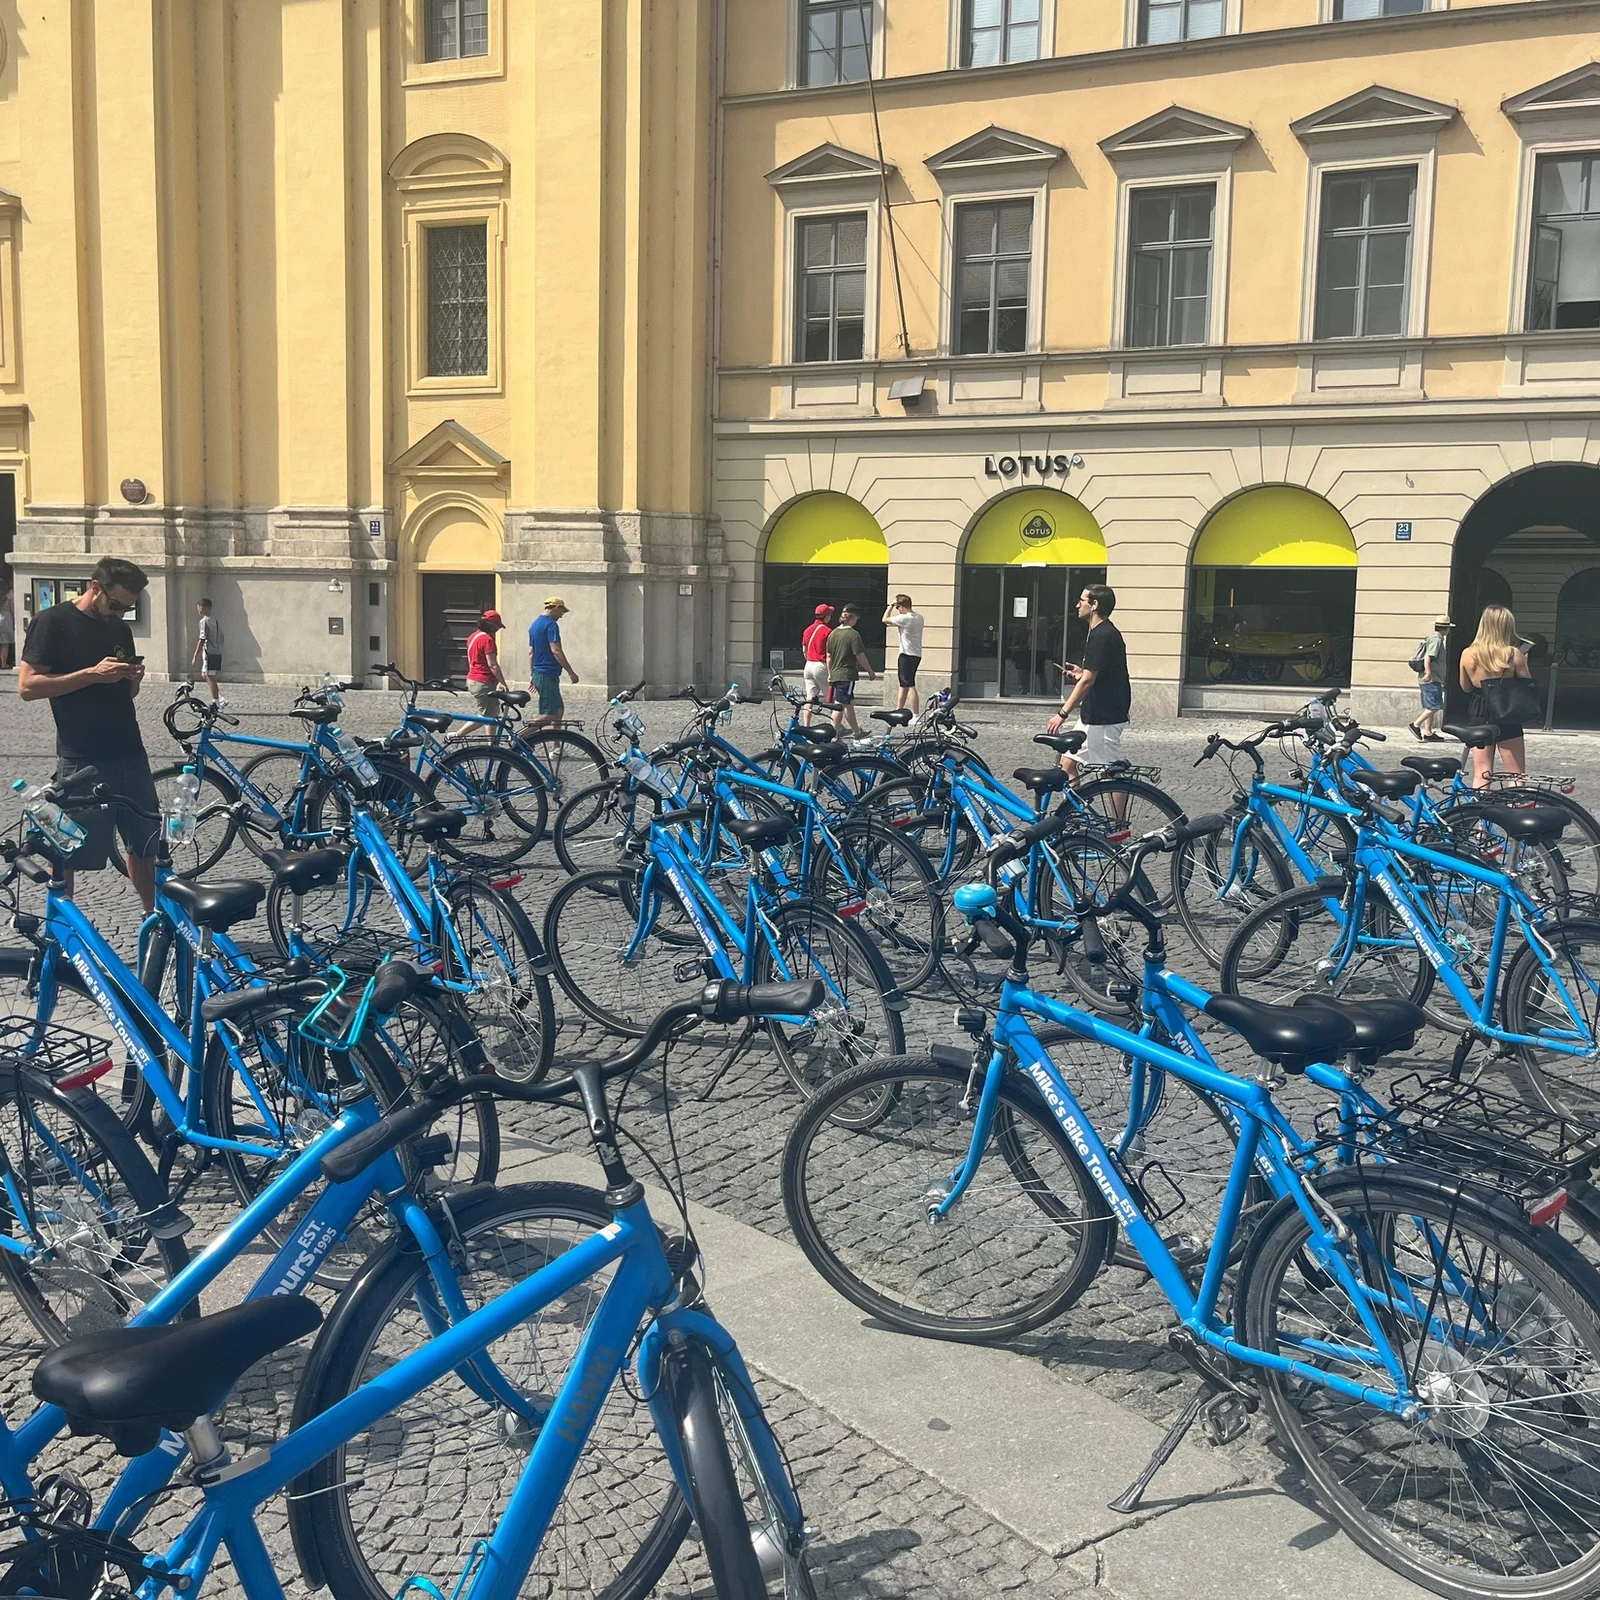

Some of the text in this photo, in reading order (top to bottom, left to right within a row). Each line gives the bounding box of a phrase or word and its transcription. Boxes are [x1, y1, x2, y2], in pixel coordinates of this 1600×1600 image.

[985, 455, 1068, 475] LOTUS
[371, 521, 379, 529] 22
[1398, 523, 1409, 531] 23
[667, 868, 710, 946] Mike's Bike Tours
[1376, 873, 1432, 958] Mike's Bike Tours
[72, 953, 137, 1055] Mike's Bike Tours
[1029, 1061, 1120, 1205] Mike's Bike Tours
[1259, 1154, 1276, 1178] EST.
[1113, 1205, 1128, 1227] 1995
[1119, 1198, 1138, 1223] EST.
[297, 1220, 325, 1249] EST.
[313, 1227, 337, 1254] 1995
